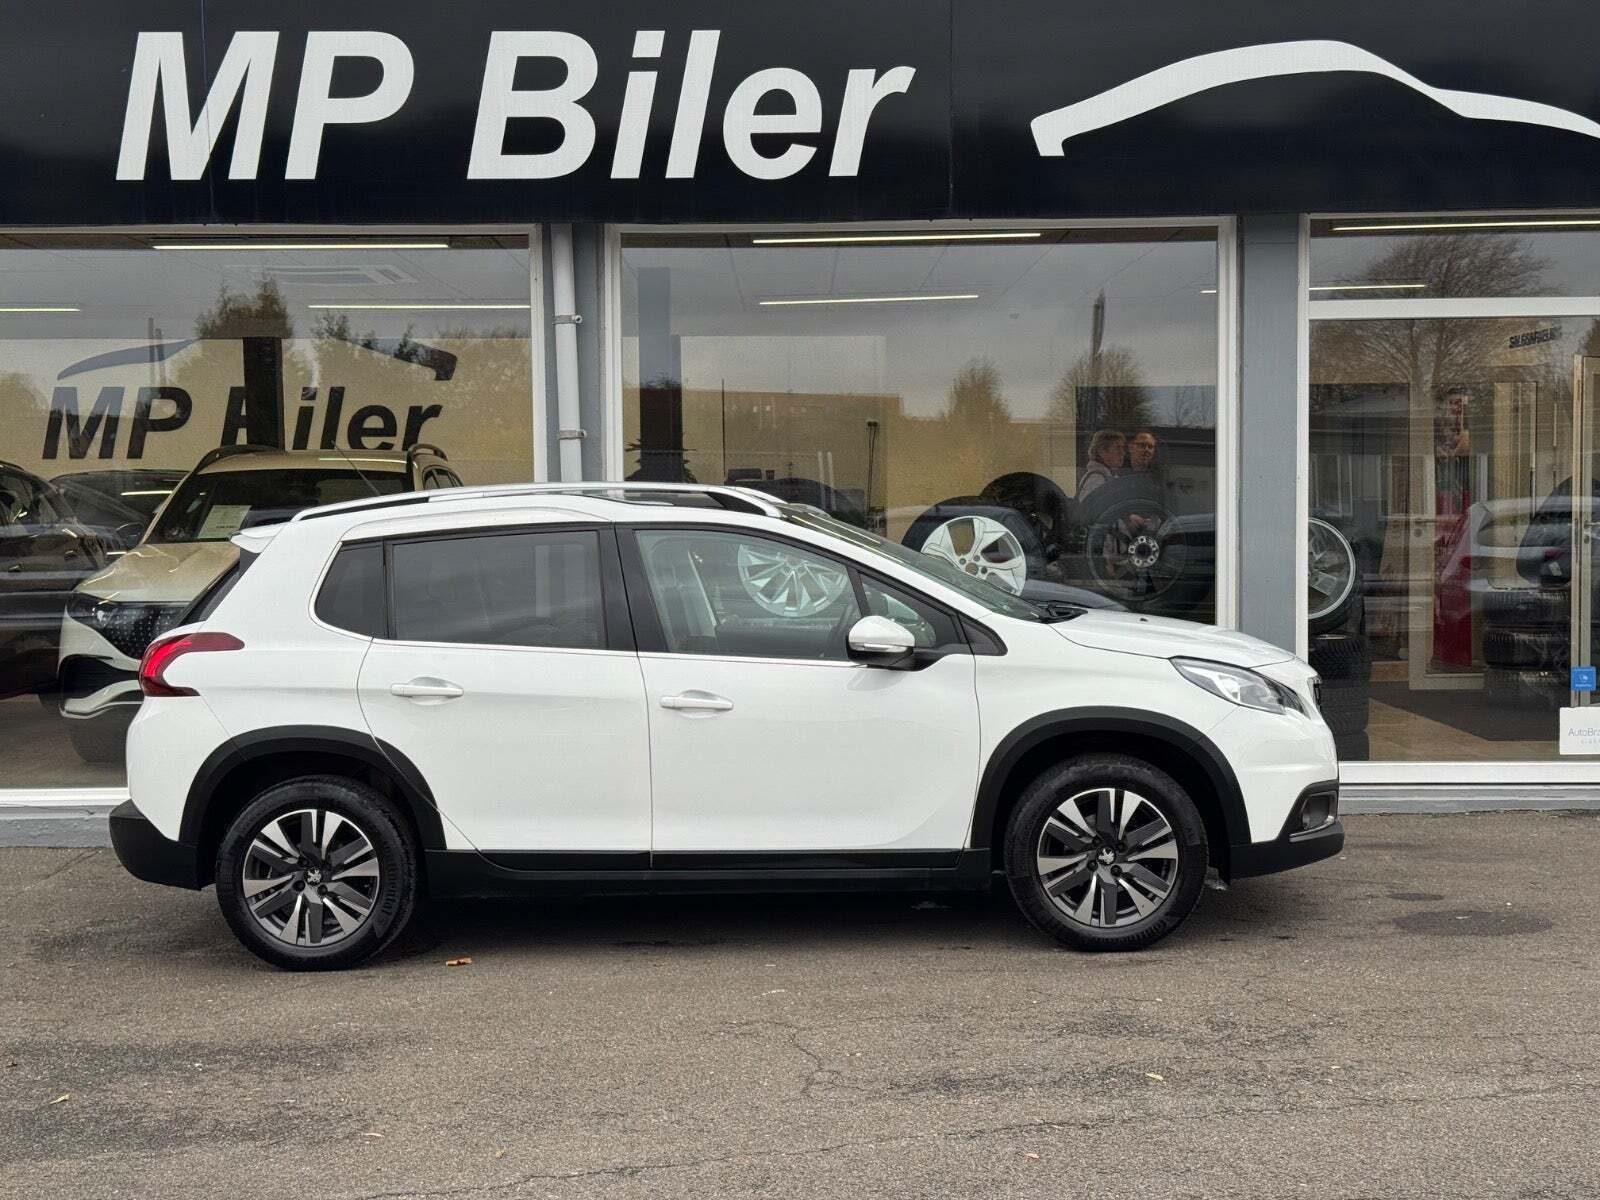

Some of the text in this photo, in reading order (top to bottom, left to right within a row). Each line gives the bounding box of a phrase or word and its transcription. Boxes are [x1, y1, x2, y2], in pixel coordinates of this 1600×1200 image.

[115, 29, 917, 182] MP Biler
[42, 385, 194, 460] MP
